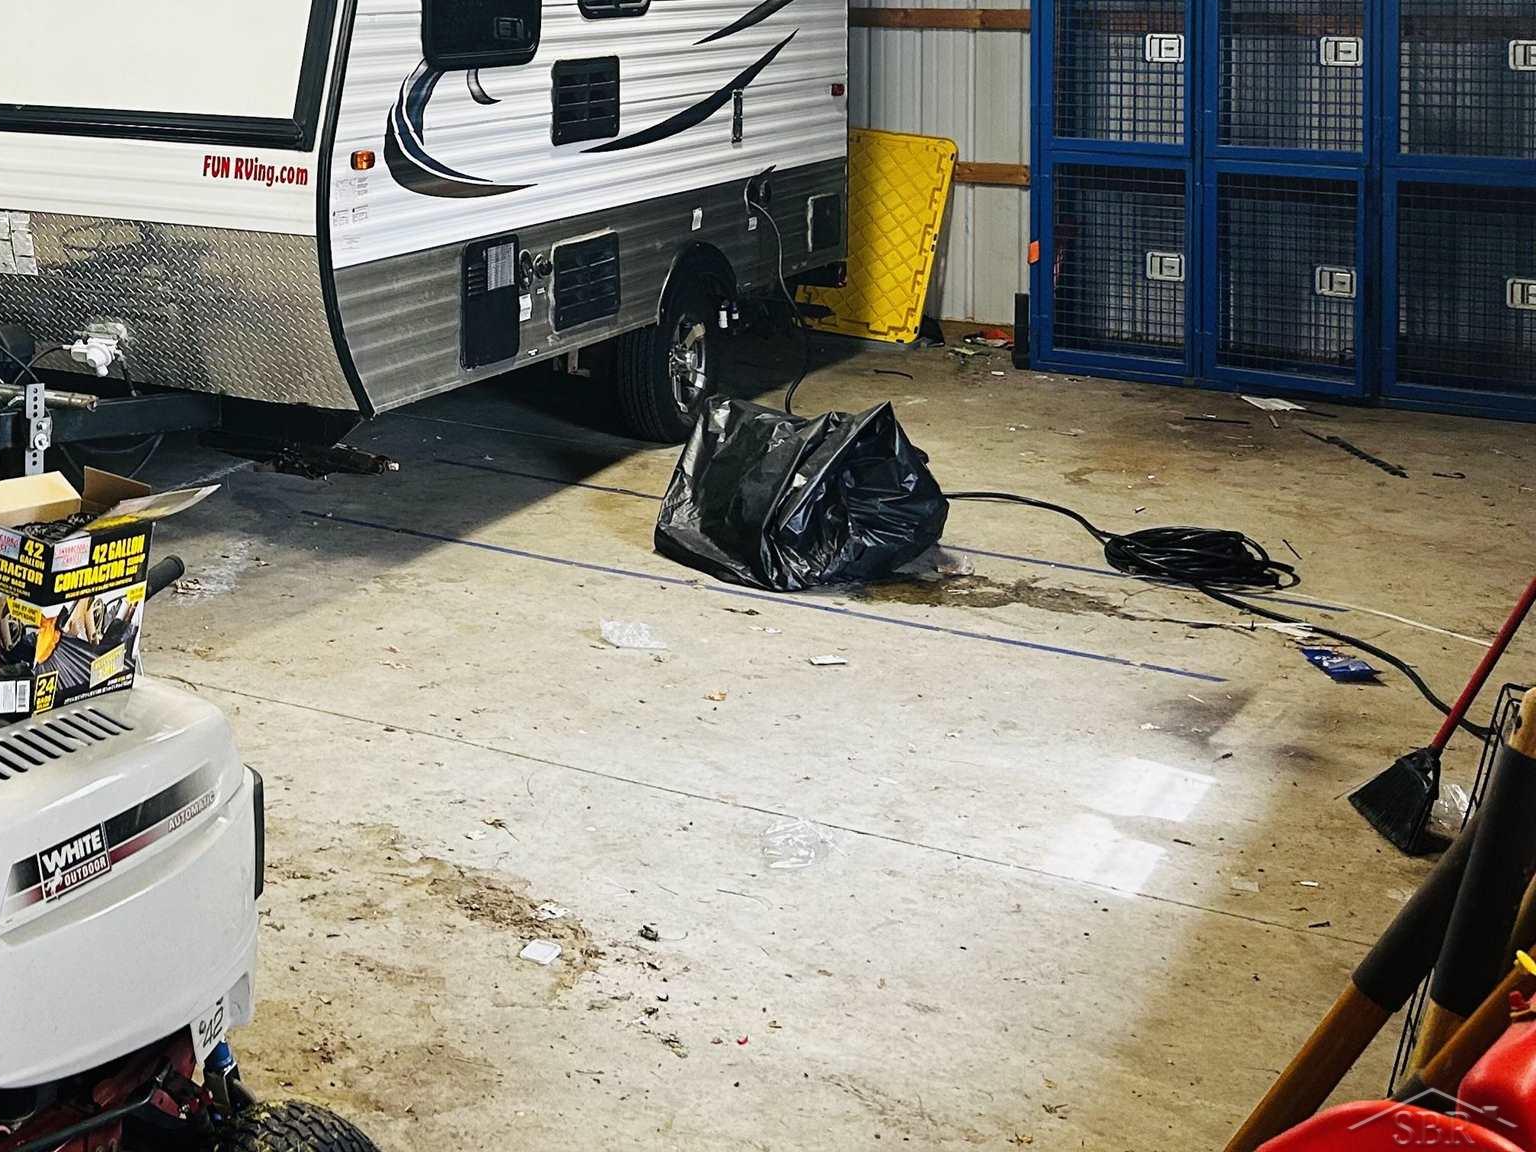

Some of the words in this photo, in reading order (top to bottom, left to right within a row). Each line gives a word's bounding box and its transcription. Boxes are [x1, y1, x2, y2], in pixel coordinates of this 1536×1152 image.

[203, 155, 230, 178] FUN
[234, 156, 308, 186] RVing.com
[20, 554, 45, 571] GALLON
[24, 539, 45, 560] 42
[92, 543, 108, 564] 42
[108, 534, 145, 561] GALLON
[54, 558, 126, 593] CONTRACTOR
[38, 677, 55, 697] 24
[168, 791, 215, 832] AUTOMATIC
[41, 828, 103, 874] WHITE
[64, 856, 107, 887] OUTDOOR
